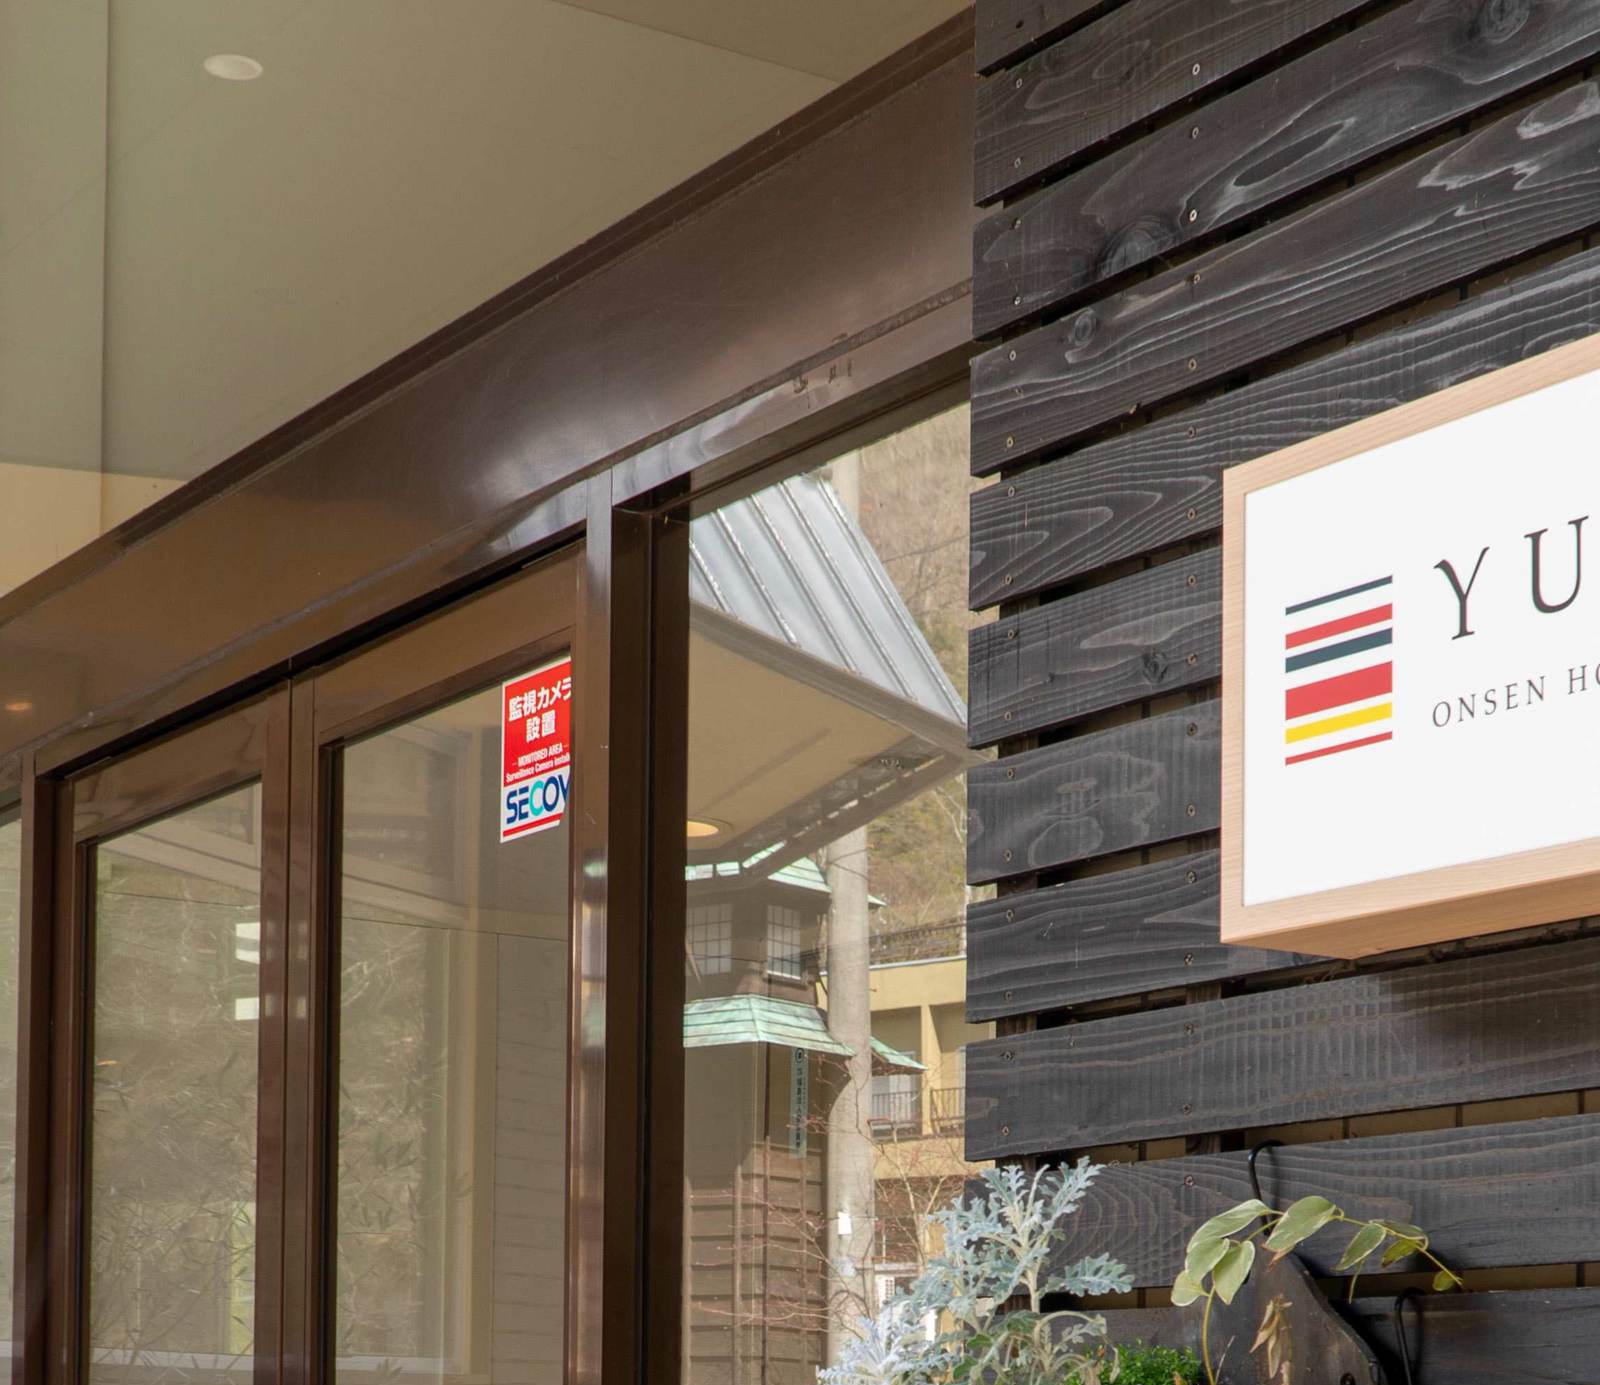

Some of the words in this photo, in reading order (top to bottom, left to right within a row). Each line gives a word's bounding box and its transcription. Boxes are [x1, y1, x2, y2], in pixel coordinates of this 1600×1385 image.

[1433, 515, 1590, 641] YU
[508, 676, 572, 722] 監視カメラ
[1432, 675, 1546, 728] ONSEN
[526, 709, 556, 743] 設置
[548, 742, 563, 757] AREA
